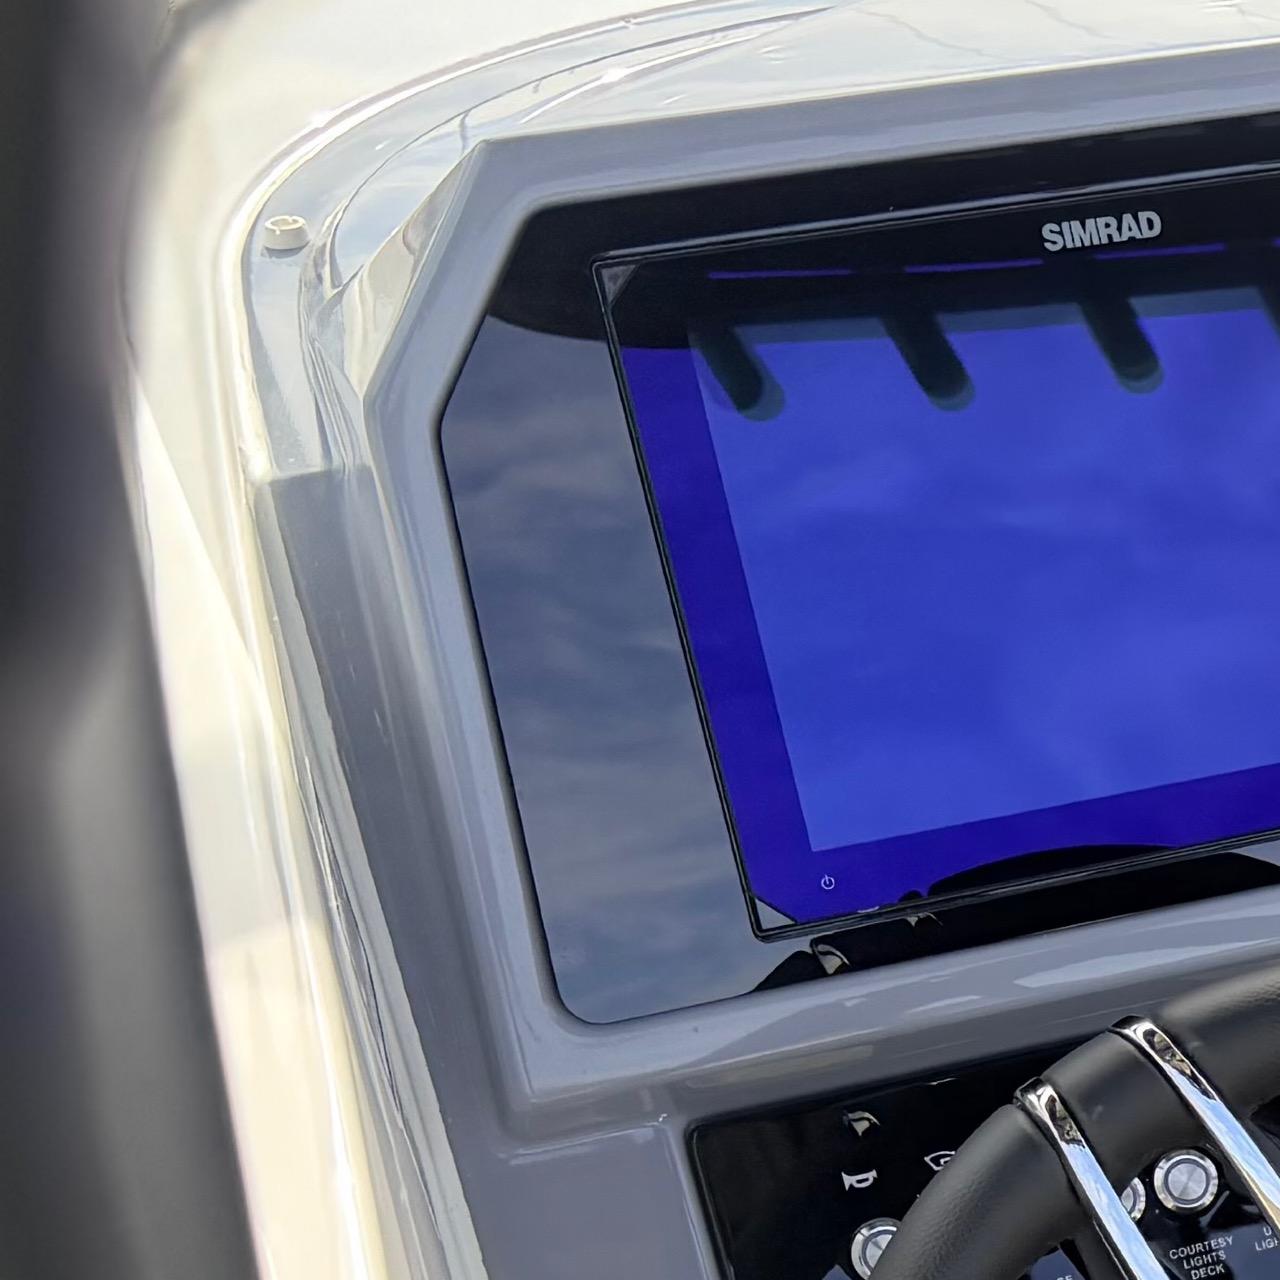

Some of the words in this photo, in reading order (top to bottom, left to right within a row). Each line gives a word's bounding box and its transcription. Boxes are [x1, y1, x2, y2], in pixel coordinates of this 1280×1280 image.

[1041, 210, 1162, 252] SIMRAD
[1168, 1235, 1234, 1260] COURTESY
[1183, 1250, 1226, 1270] LIGHTS
[1190, 1263, 1226, 1280] DECK
